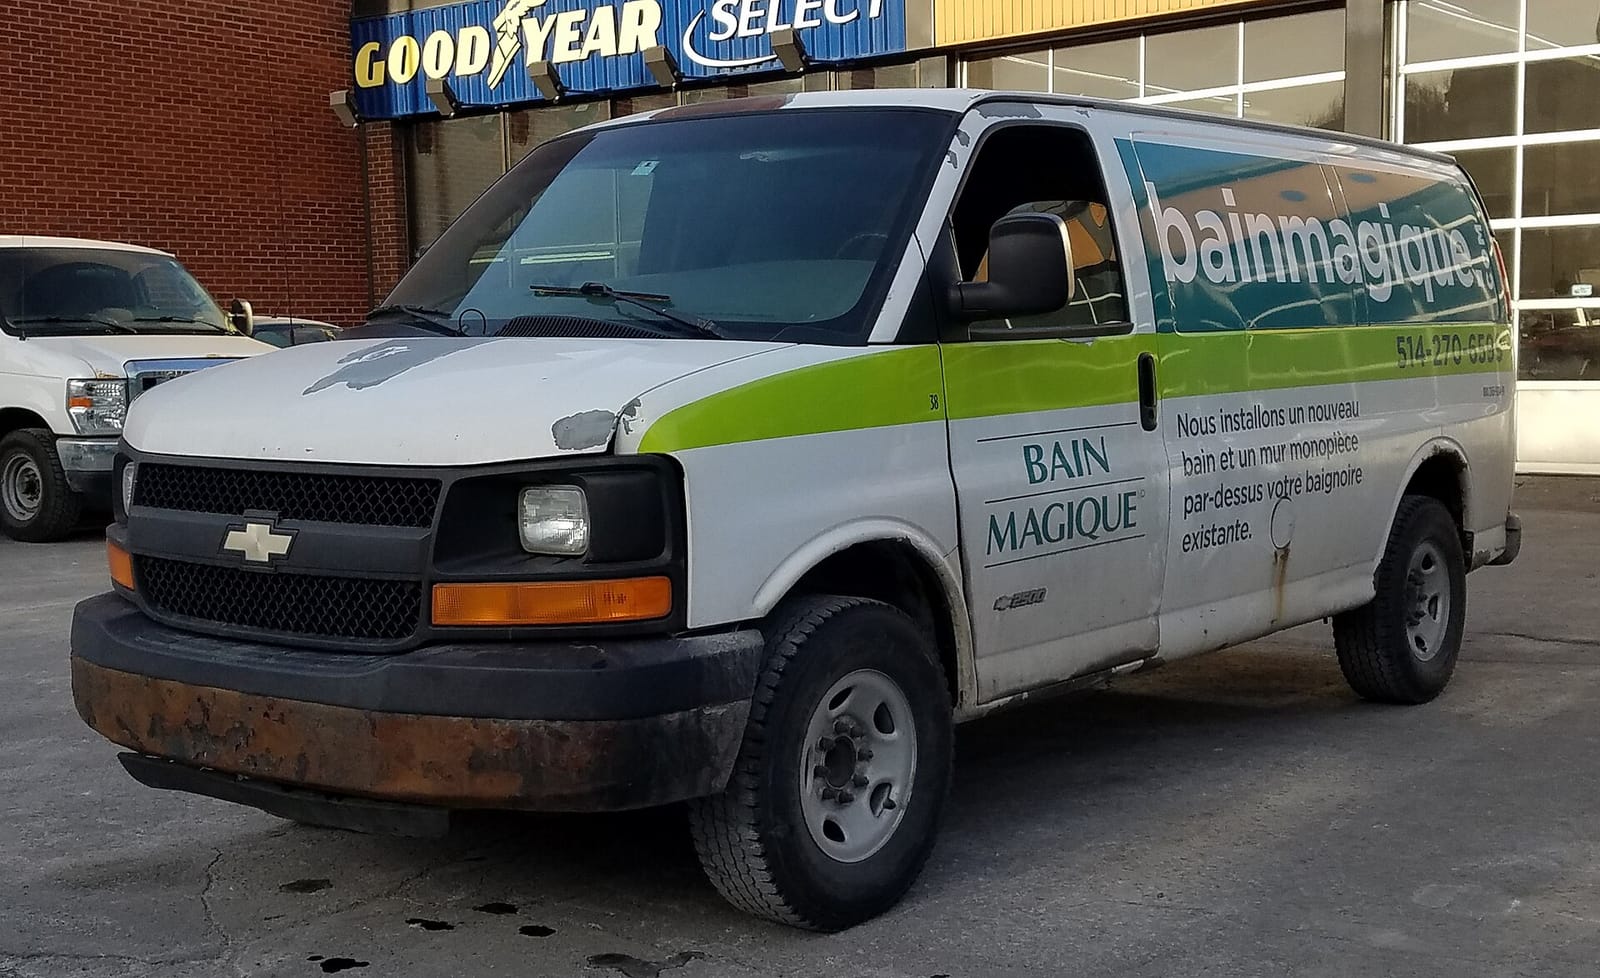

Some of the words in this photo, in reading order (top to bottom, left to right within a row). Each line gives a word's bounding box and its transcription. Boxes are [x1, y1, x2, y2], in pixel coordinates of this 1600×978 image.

[355, 0, 662, 88] GOODYEAR
[929, 394, 939, 410] 38
[1177, 412, 1217, 438] Nous
[1220, 404, 1286, 433] installons
[1289, 406, 1305, 425] un
[1308, 400, 1360, 422] nouveau
[1023, 436, 1110, 485] BAIN
[1182, 450, 1216, 477] bain
[1220, 446, 1235, 471] et
[1238, 447, 1257, 468] un
[1260, 443, 1287, 465] mur
[1290, 431, 1359, 460] monopièce
[1183, 482, 1264, 521] par-dessus
[1267, 474, 1302, 500] votre
[1305, 464, 1363, 495] baignoire
[986, 491, 1137, 556] MAGIQUE
[1181, 519, 1252, 553] existante.
